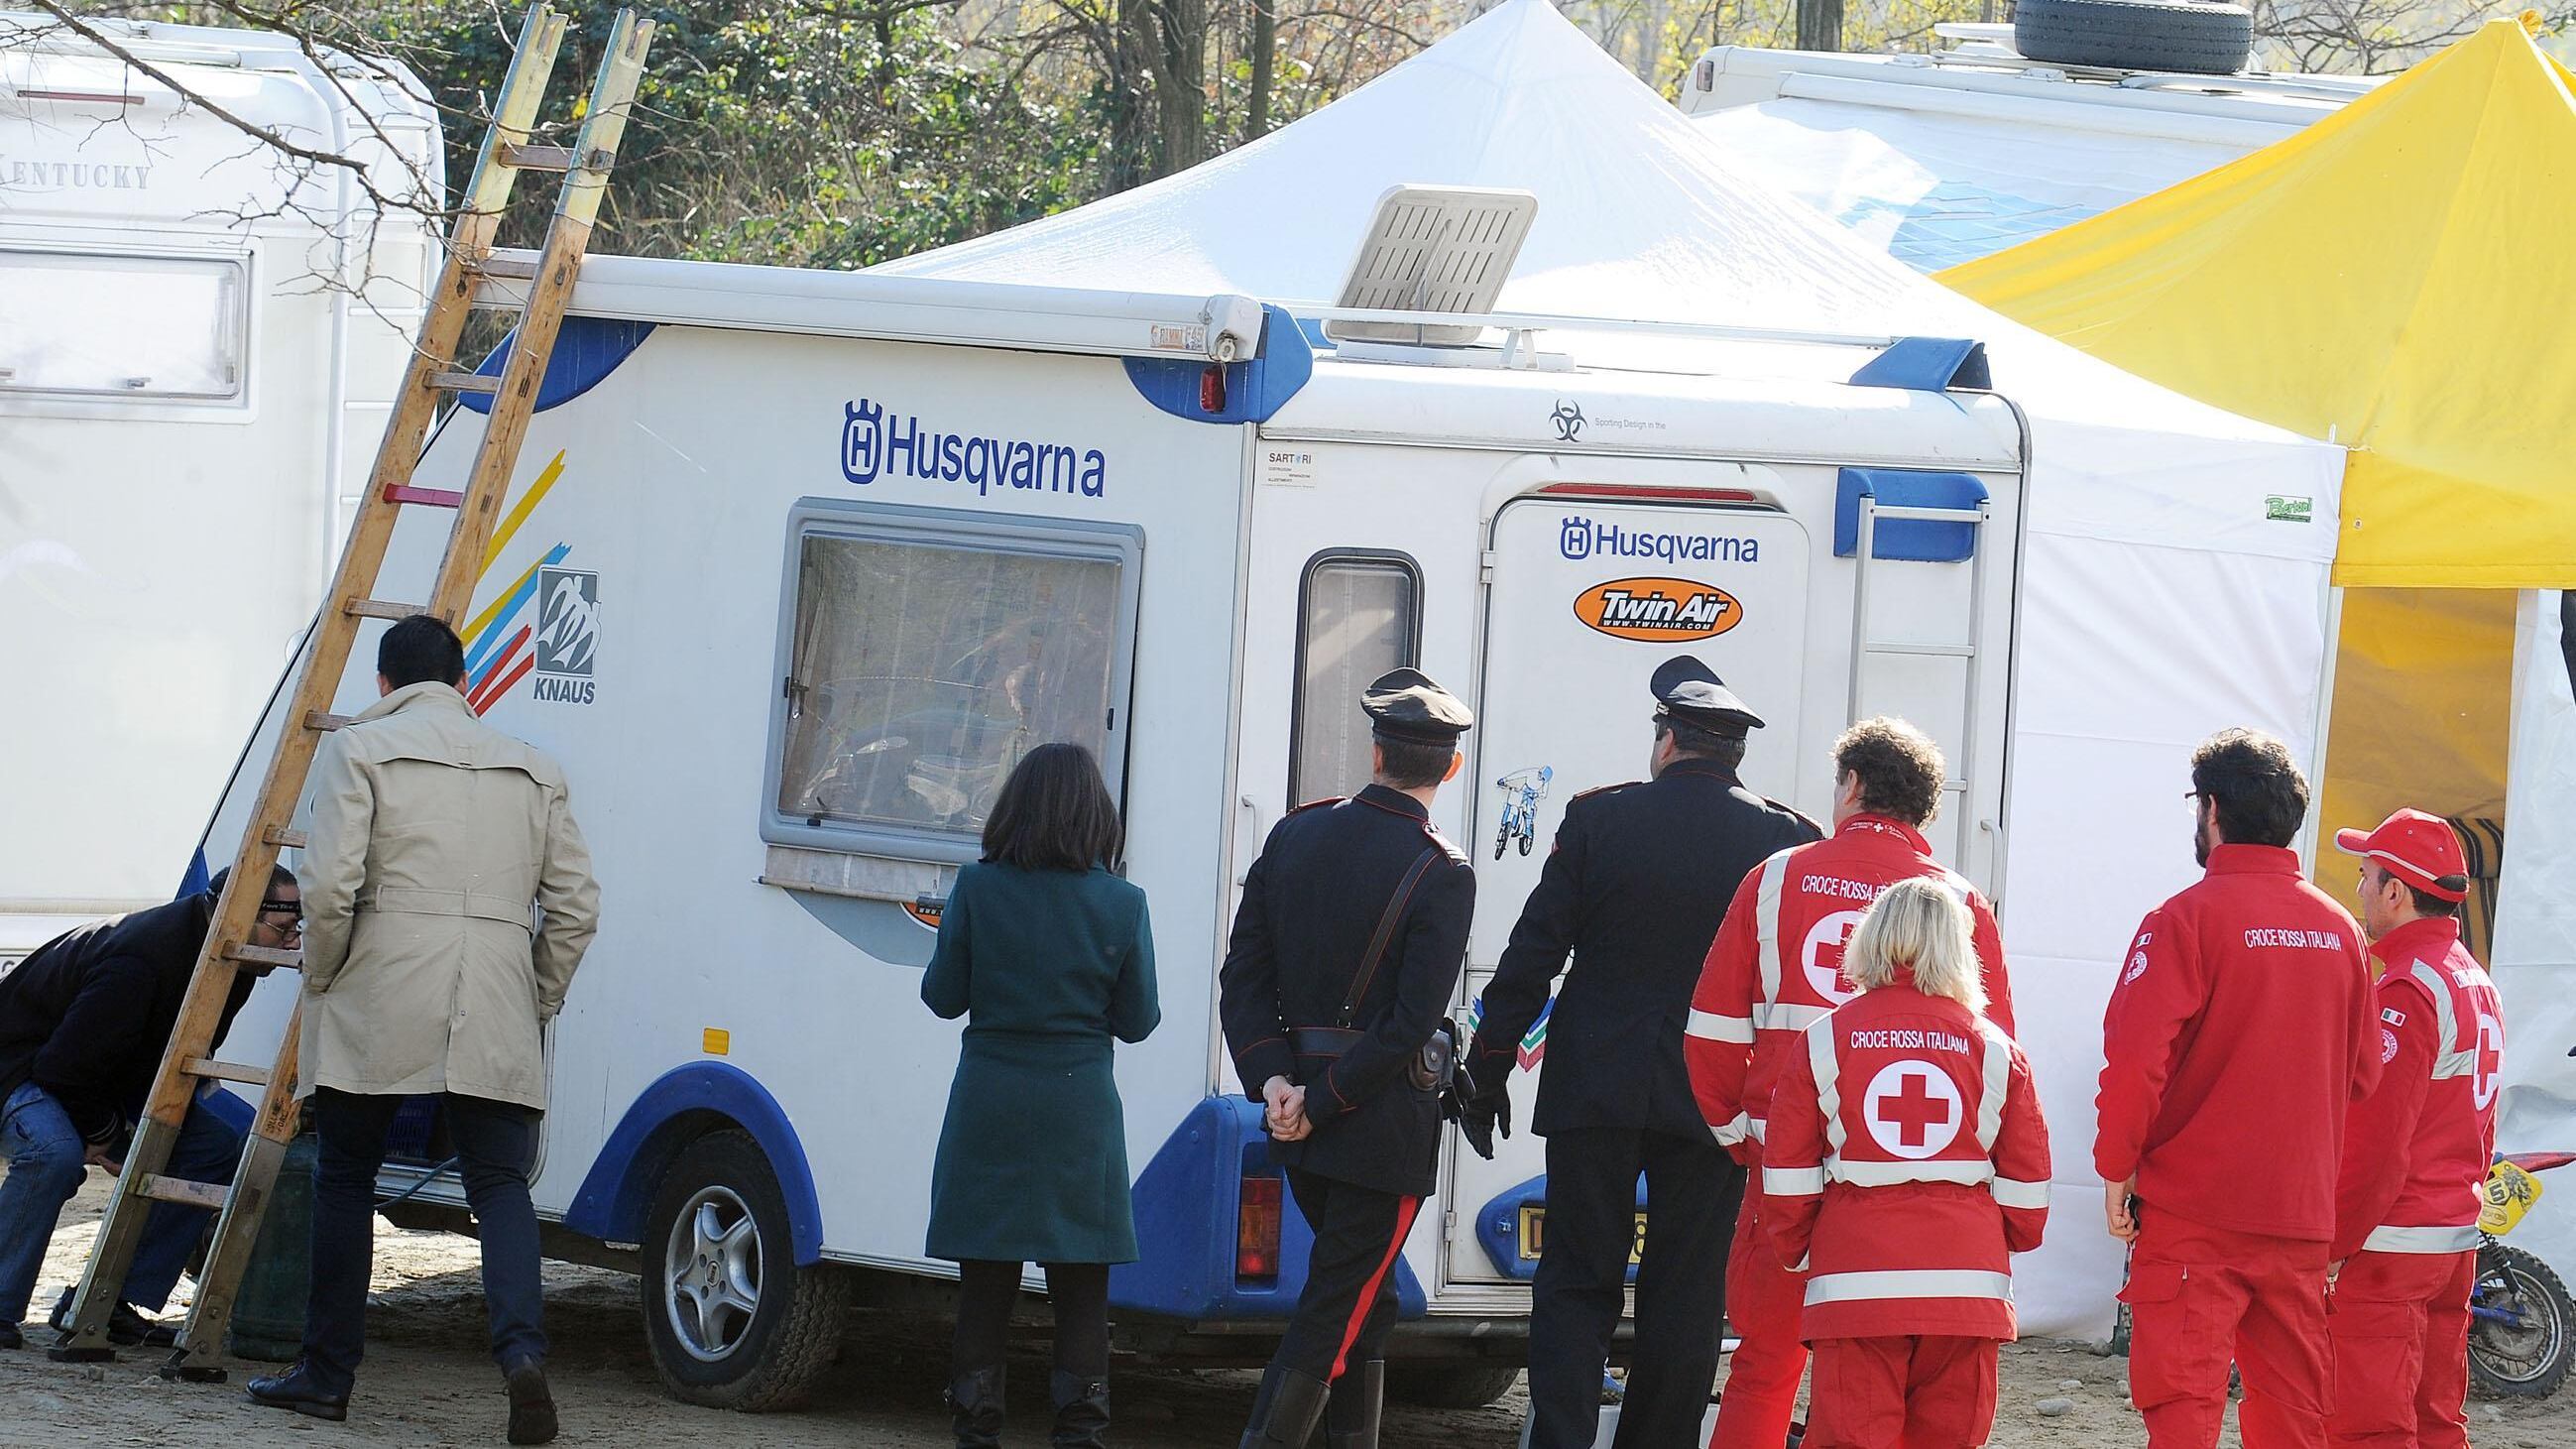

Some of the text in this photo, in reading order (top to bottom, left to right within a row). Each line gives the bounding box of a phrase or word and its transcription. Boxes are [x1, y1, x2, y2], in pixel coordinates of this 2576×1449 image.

[1623, 419, 1647, 430] Design
[886, 414, 1106, 498] Husqvarna
[1595, 524, 1759, 564] Husqvarna
[1602, 591, 1728, 624] Twin Air
[1602, 620, 1711, 631] WWW.TWINAIR.COM
[533, 676, 596, 705] KNAUS
[1802, 874, 1839, 897] CROCE
[1839, 880, 1873, 902] ROSSA
[2244, 928, 2342, 952] CROCE ROSSA ITALIANA
[1850, 1029, 1970, 1056] CROCE ROSSA ITALIANA
